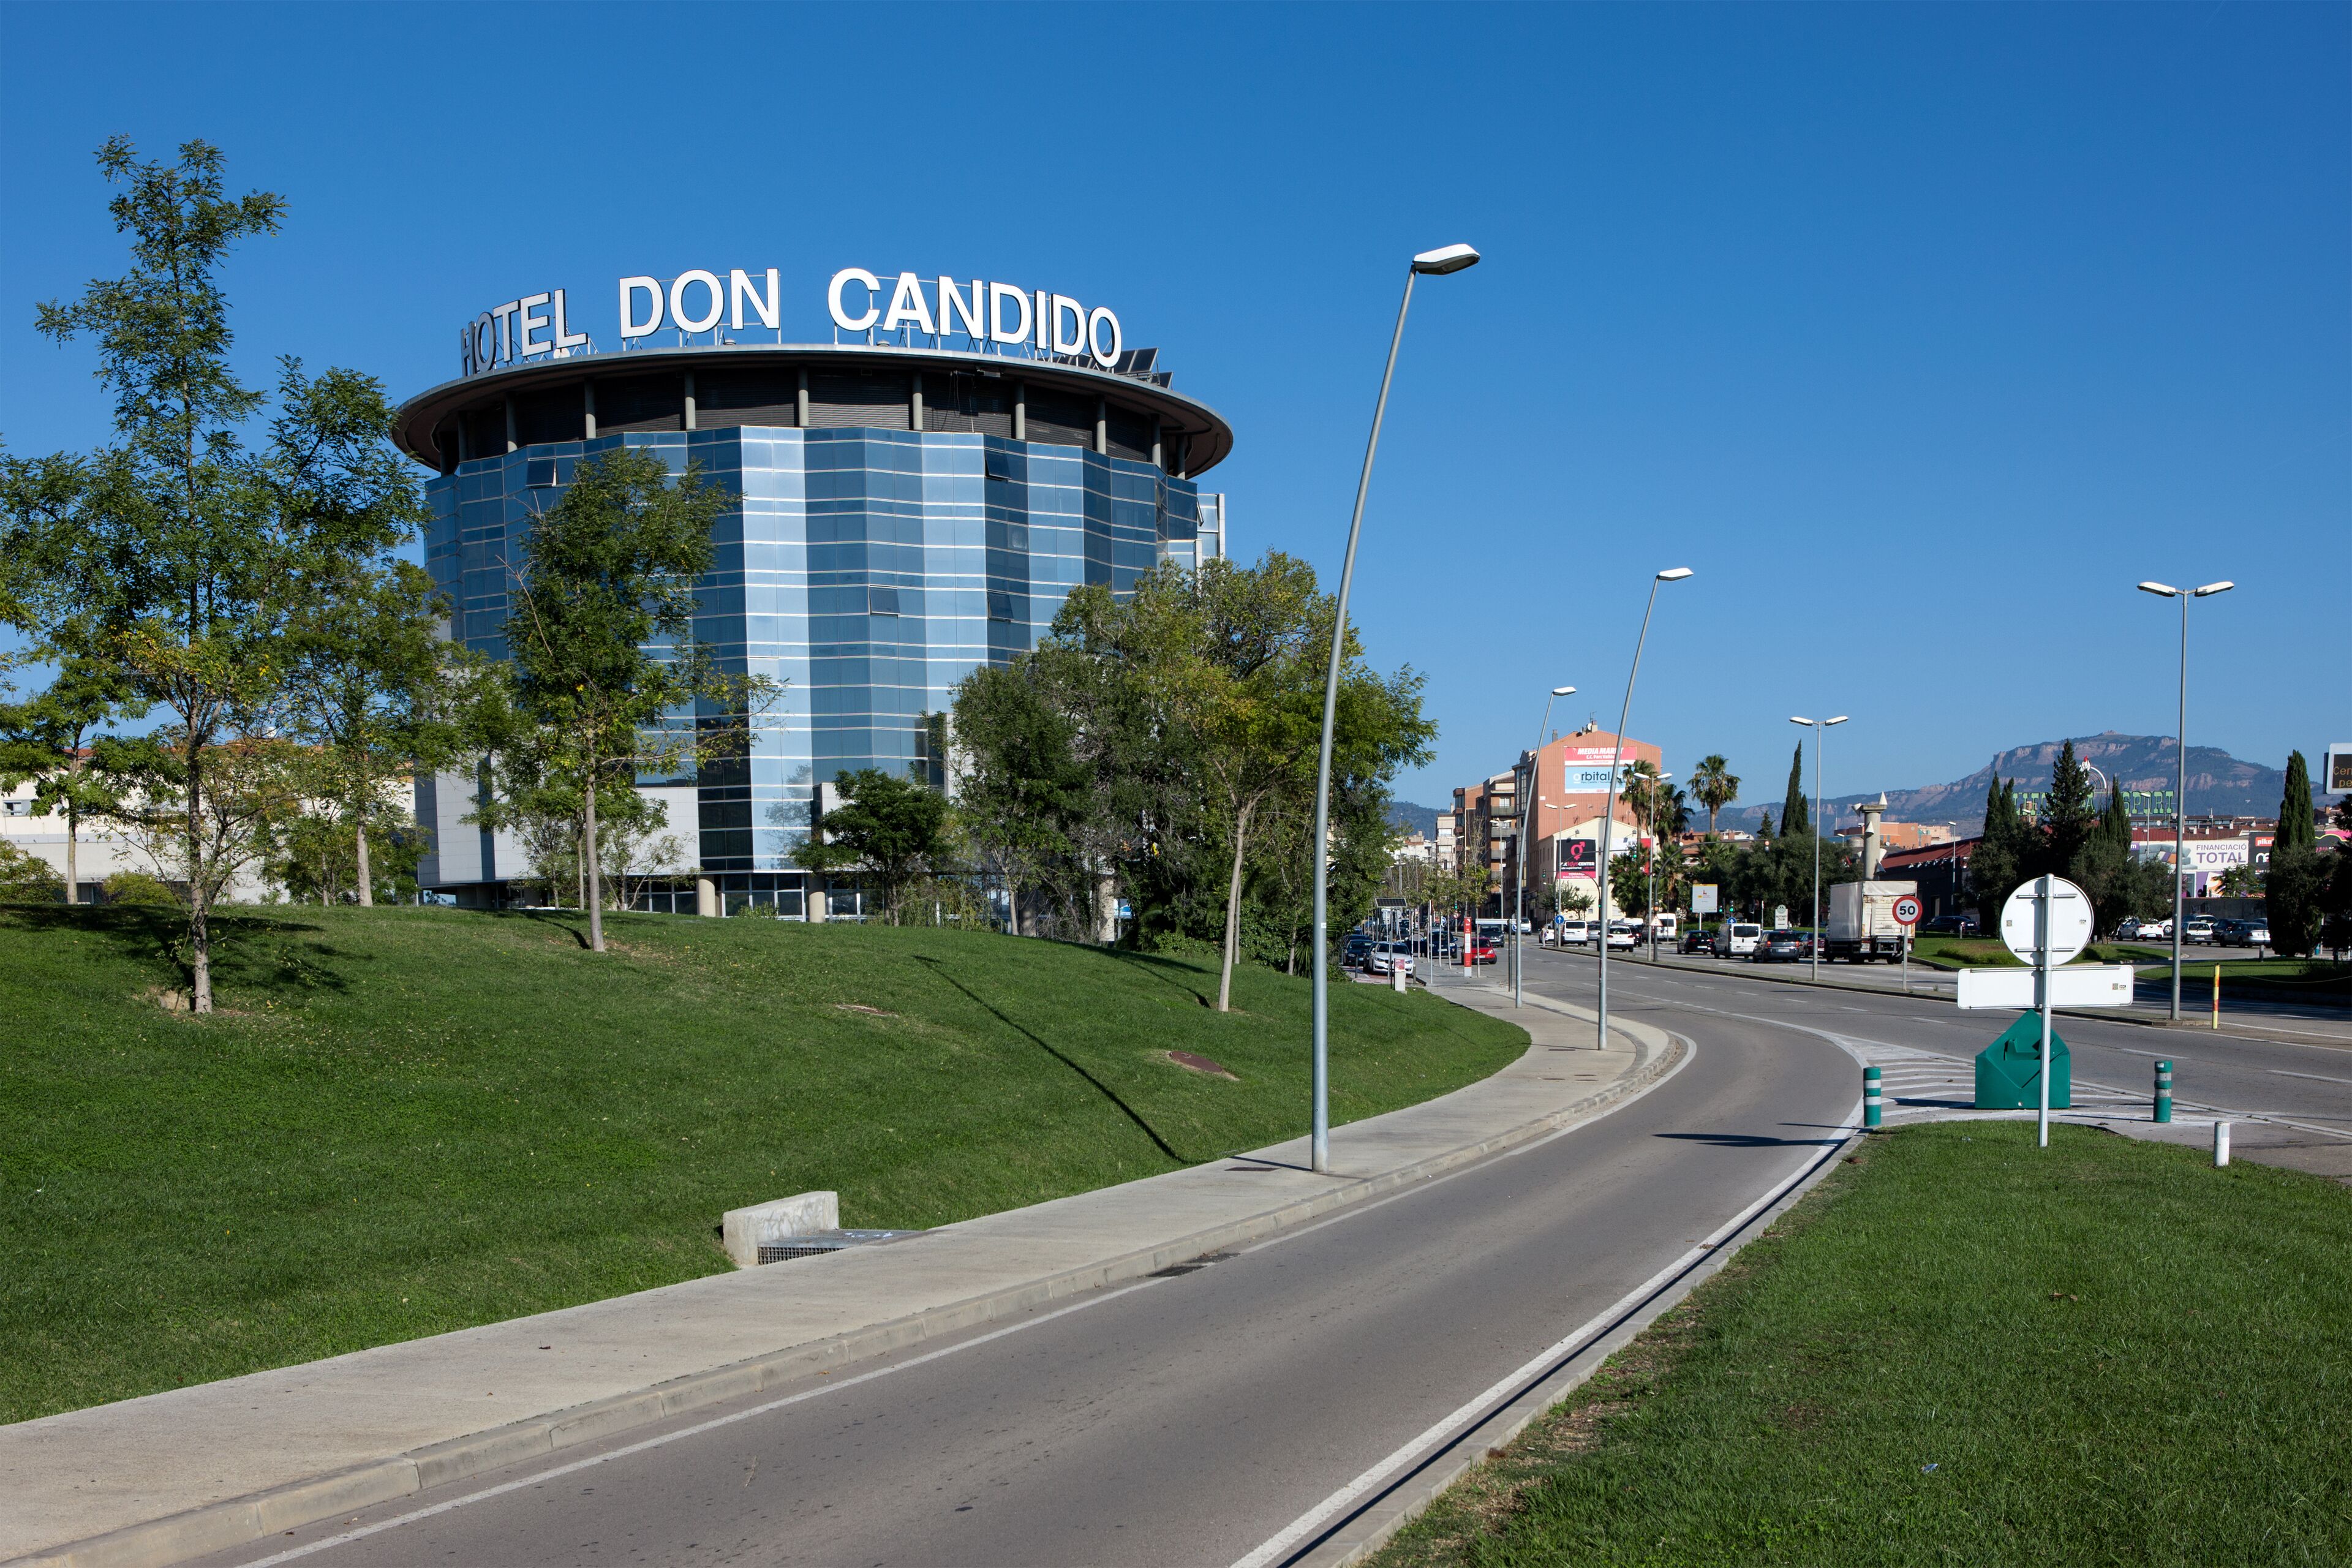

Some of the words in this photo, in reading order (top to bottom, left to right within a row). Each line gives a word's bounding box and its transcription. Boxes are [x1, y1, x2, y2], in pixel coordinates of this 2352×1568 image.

[460, 288, 588, 377] HOTEL
[619, 268, 780, 339] DON
[827, 268, 1122, 368] CANDIDO
[2122, 791, 2174, 815] SPORT
[2196, 842, 2247, 851] FINANCIACIÓ
[2196, 852, 2247, 864] TOTAL
[1899, 905, 1916, 915] 50
